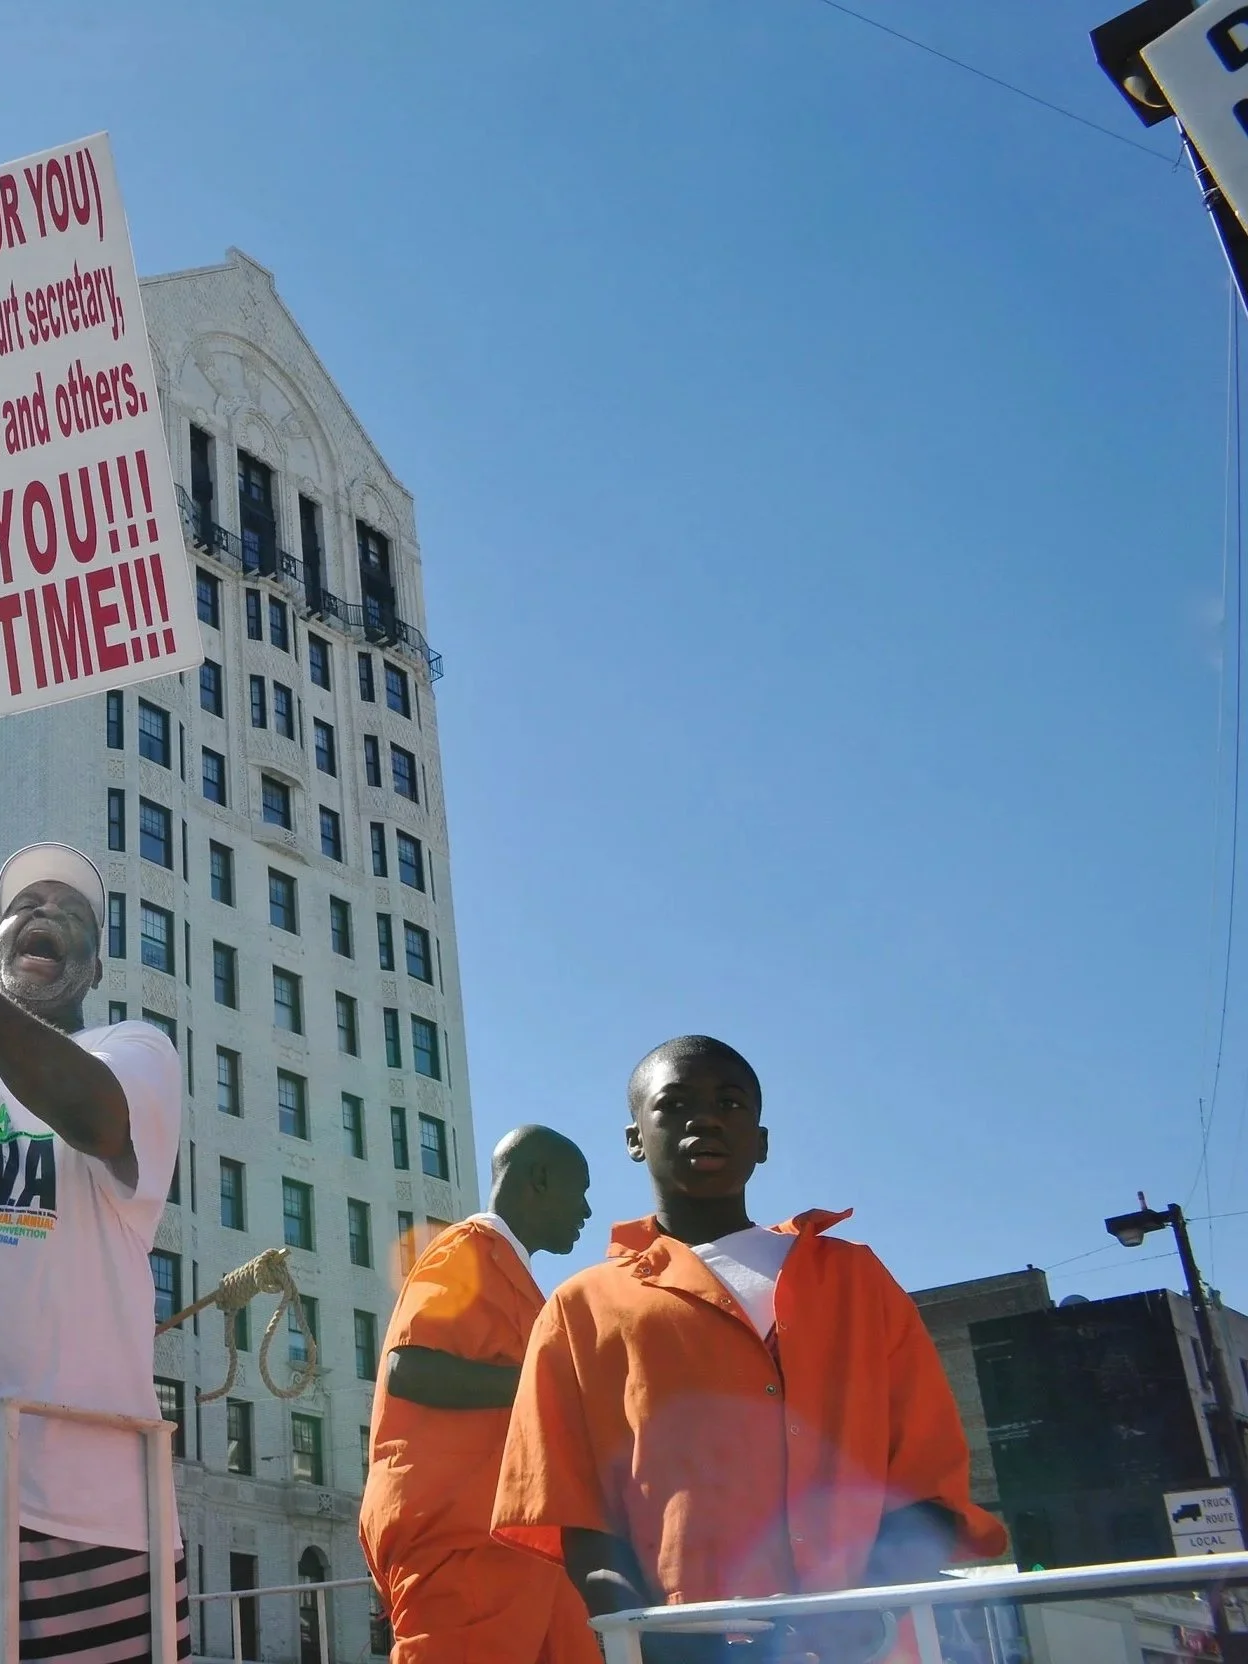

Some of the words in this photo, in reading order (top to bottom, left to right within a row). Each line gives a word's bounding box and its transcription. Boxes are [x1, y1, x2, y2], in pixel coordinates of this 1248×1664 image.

[24, 148, 105, 241] YOU)
[25, 258, 126, 346] secretary,
[2, 371, 51, 455] and
[55, 359, 148, 438] others.
[16, 1214, 56, 1230] ANNUAL
[1201, 1497, 1231, 1508] TRUCK
[1205, 1512, 1235, 1524] ROUTE
[1189, 1536, 1226, 1547] LOCAL
